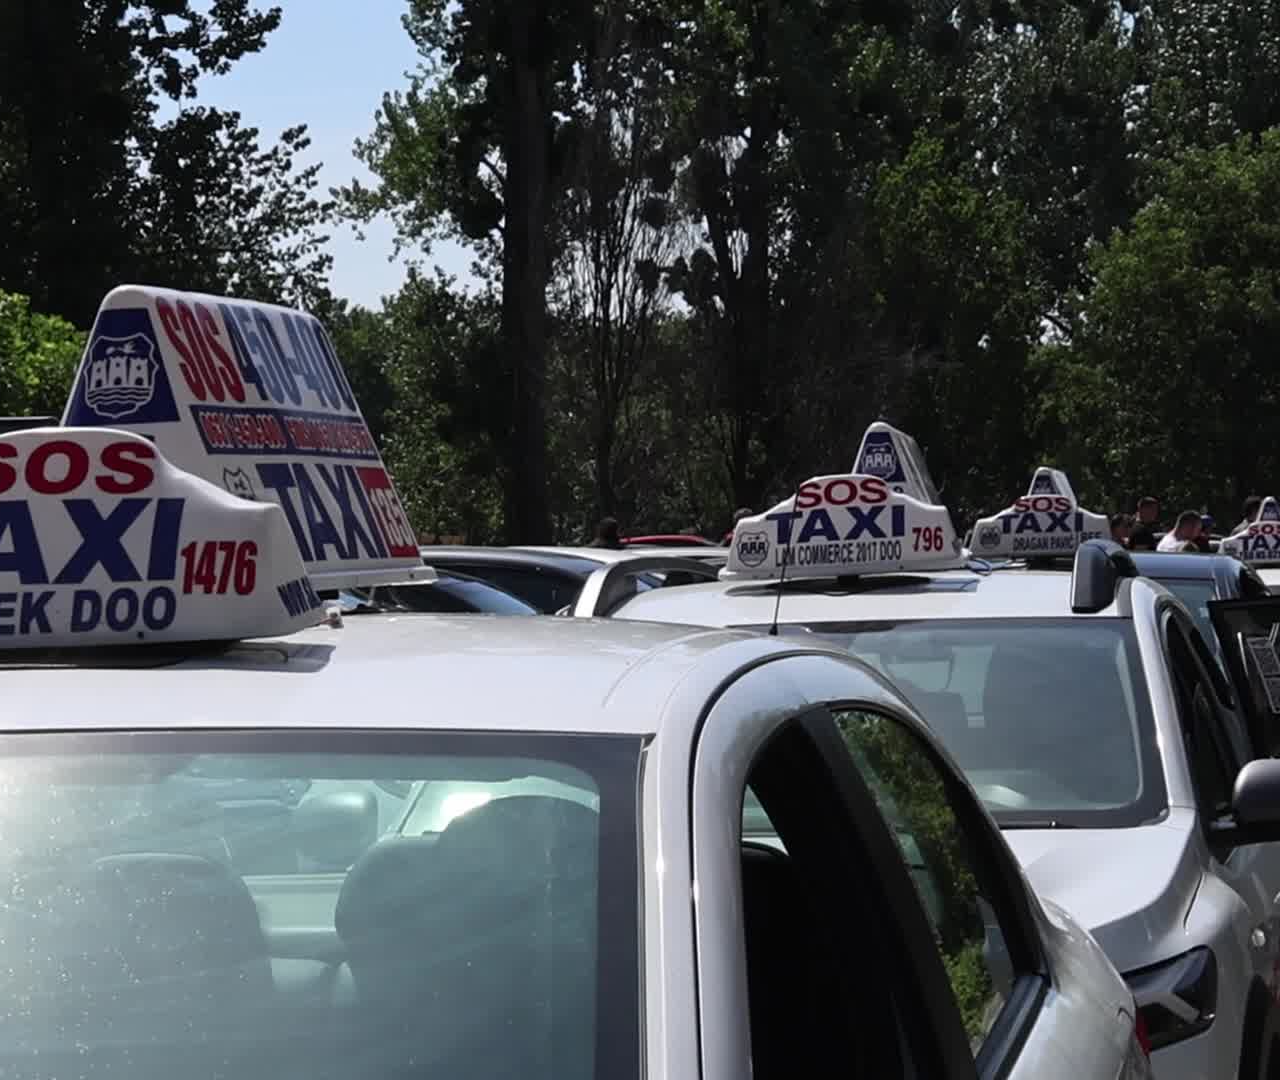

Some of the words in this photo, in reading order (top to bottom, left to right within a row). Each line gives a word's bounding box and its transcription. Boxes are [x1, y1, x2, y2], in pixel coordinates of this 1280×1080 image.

[156, 296, 247, 403] SOS
[798, 478, 889, 509] SOS
[1011, 496, 1072, 513] SOS
[256, 462, 388, 562] TAXI
[767, 504, 905, 545] TAXI
[998, 511, 1084, 535] TAXI
[798, 542, 855, 566] COMMERCE
[856, 541, 878, 563] 2017
[879, 540, 902, 561] DOO
[912, 526, 944, 552] 796
[180, 539, 259, 596] 1476
[70, 586, 177, 634] DOO
